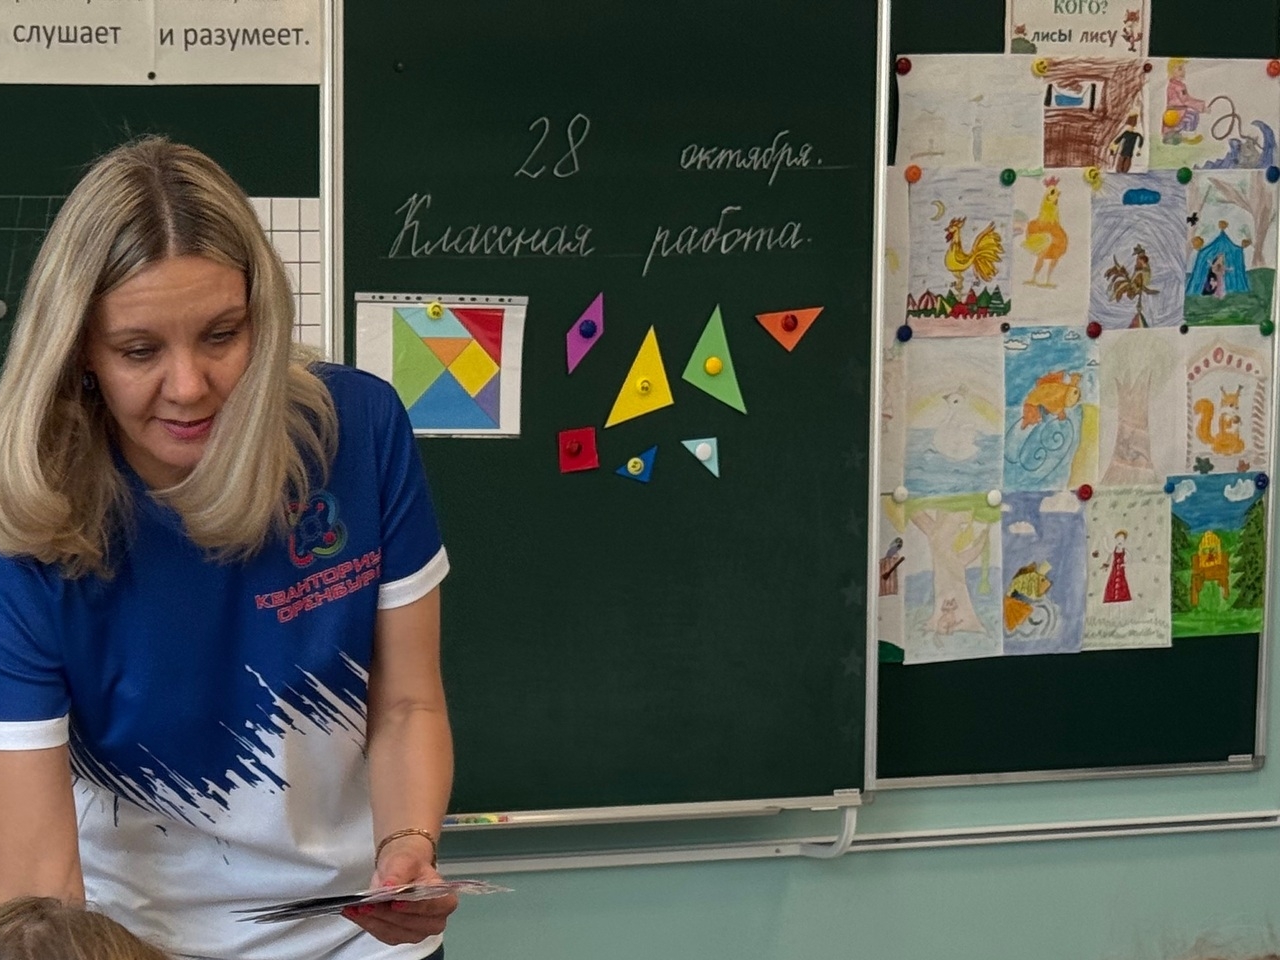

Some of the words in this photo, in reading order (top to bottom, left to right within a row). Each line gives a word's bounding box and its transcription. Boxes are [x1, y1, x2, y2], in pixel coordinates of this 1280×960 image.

[12, 23, 121, 50] слушает
[158, 27, 174, 46] и
[183, 27, 311, 51] разумеет.
[1031, 29, 1072, 42] лисы
[1079, 30, 1118, 47] лису
[514, 113, 590, 179] 28
[679, 130, 823, 186] октября.
[387, 193, 596, 258] Классная
[642, 206, 813, 277] работа.
[277, 563, 382, 623] ОРЕНБУР
